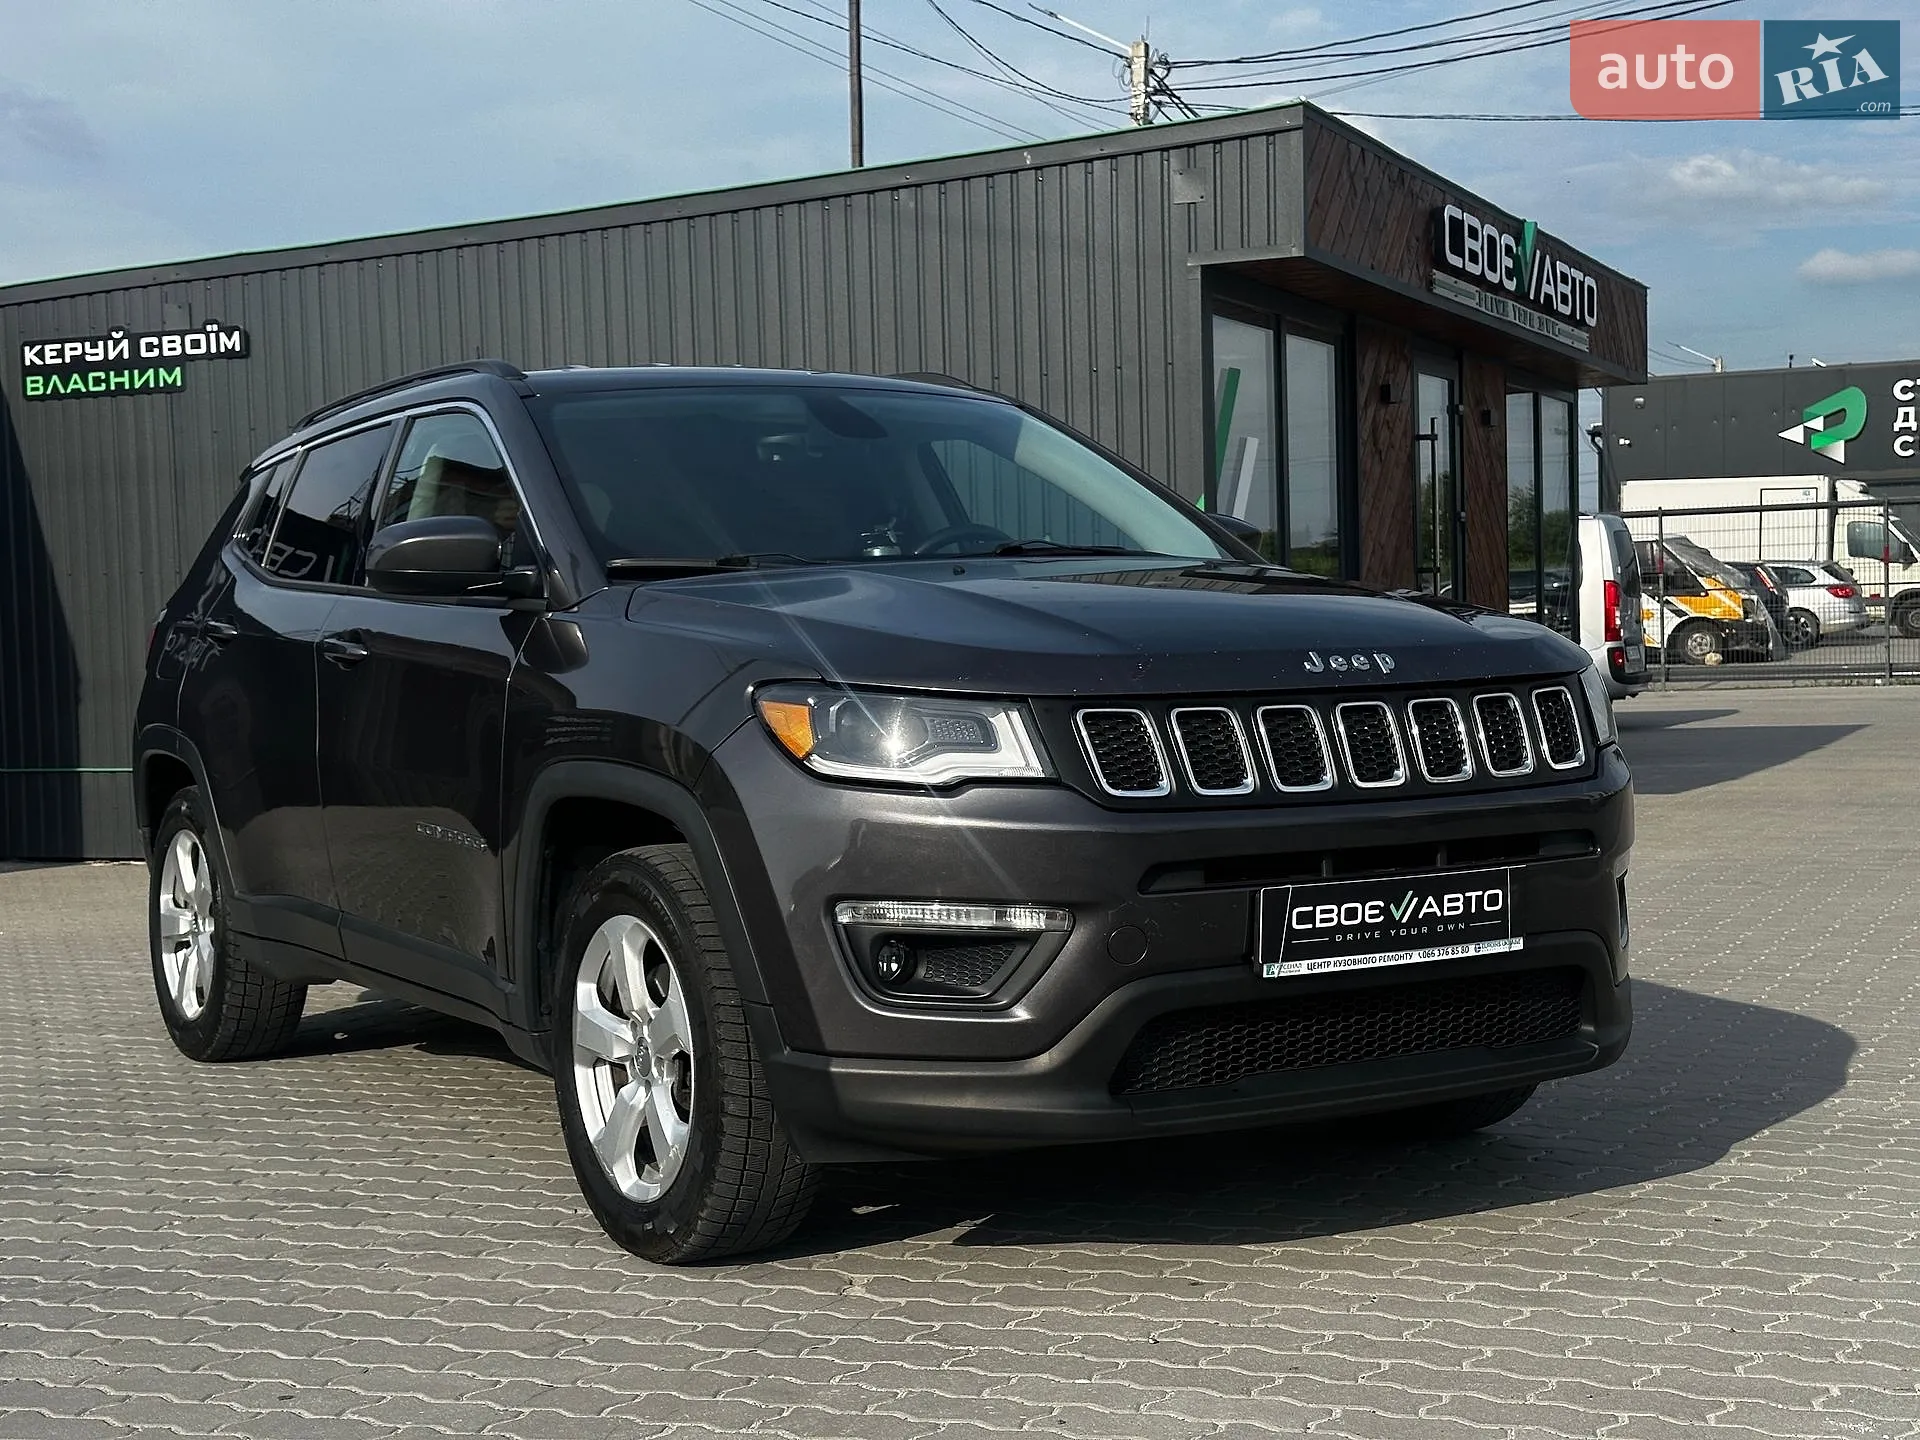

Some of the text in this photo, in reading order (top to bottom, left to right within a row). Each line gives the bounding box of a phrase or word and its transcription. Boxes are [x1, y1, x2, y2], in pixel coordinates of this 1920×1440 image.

[1540, 253, 1598, 328] АВТО
[23, 323, 241, 366] КЕРУЙ СВОЇМ
[25, 366, 182, 396] ВЛАСНИМ
[1892, 378, 1920, 402] С
[1303, 651, 1395, 674] Jeep
[1418, 889, 1503, 919] АВТО
[1335, 922, 1466, 942] DRIVE YOUR OWN
[1306, 952, 1413, 971] ЦЕНТР КУЗОВНОГО РЕМОНТУ
